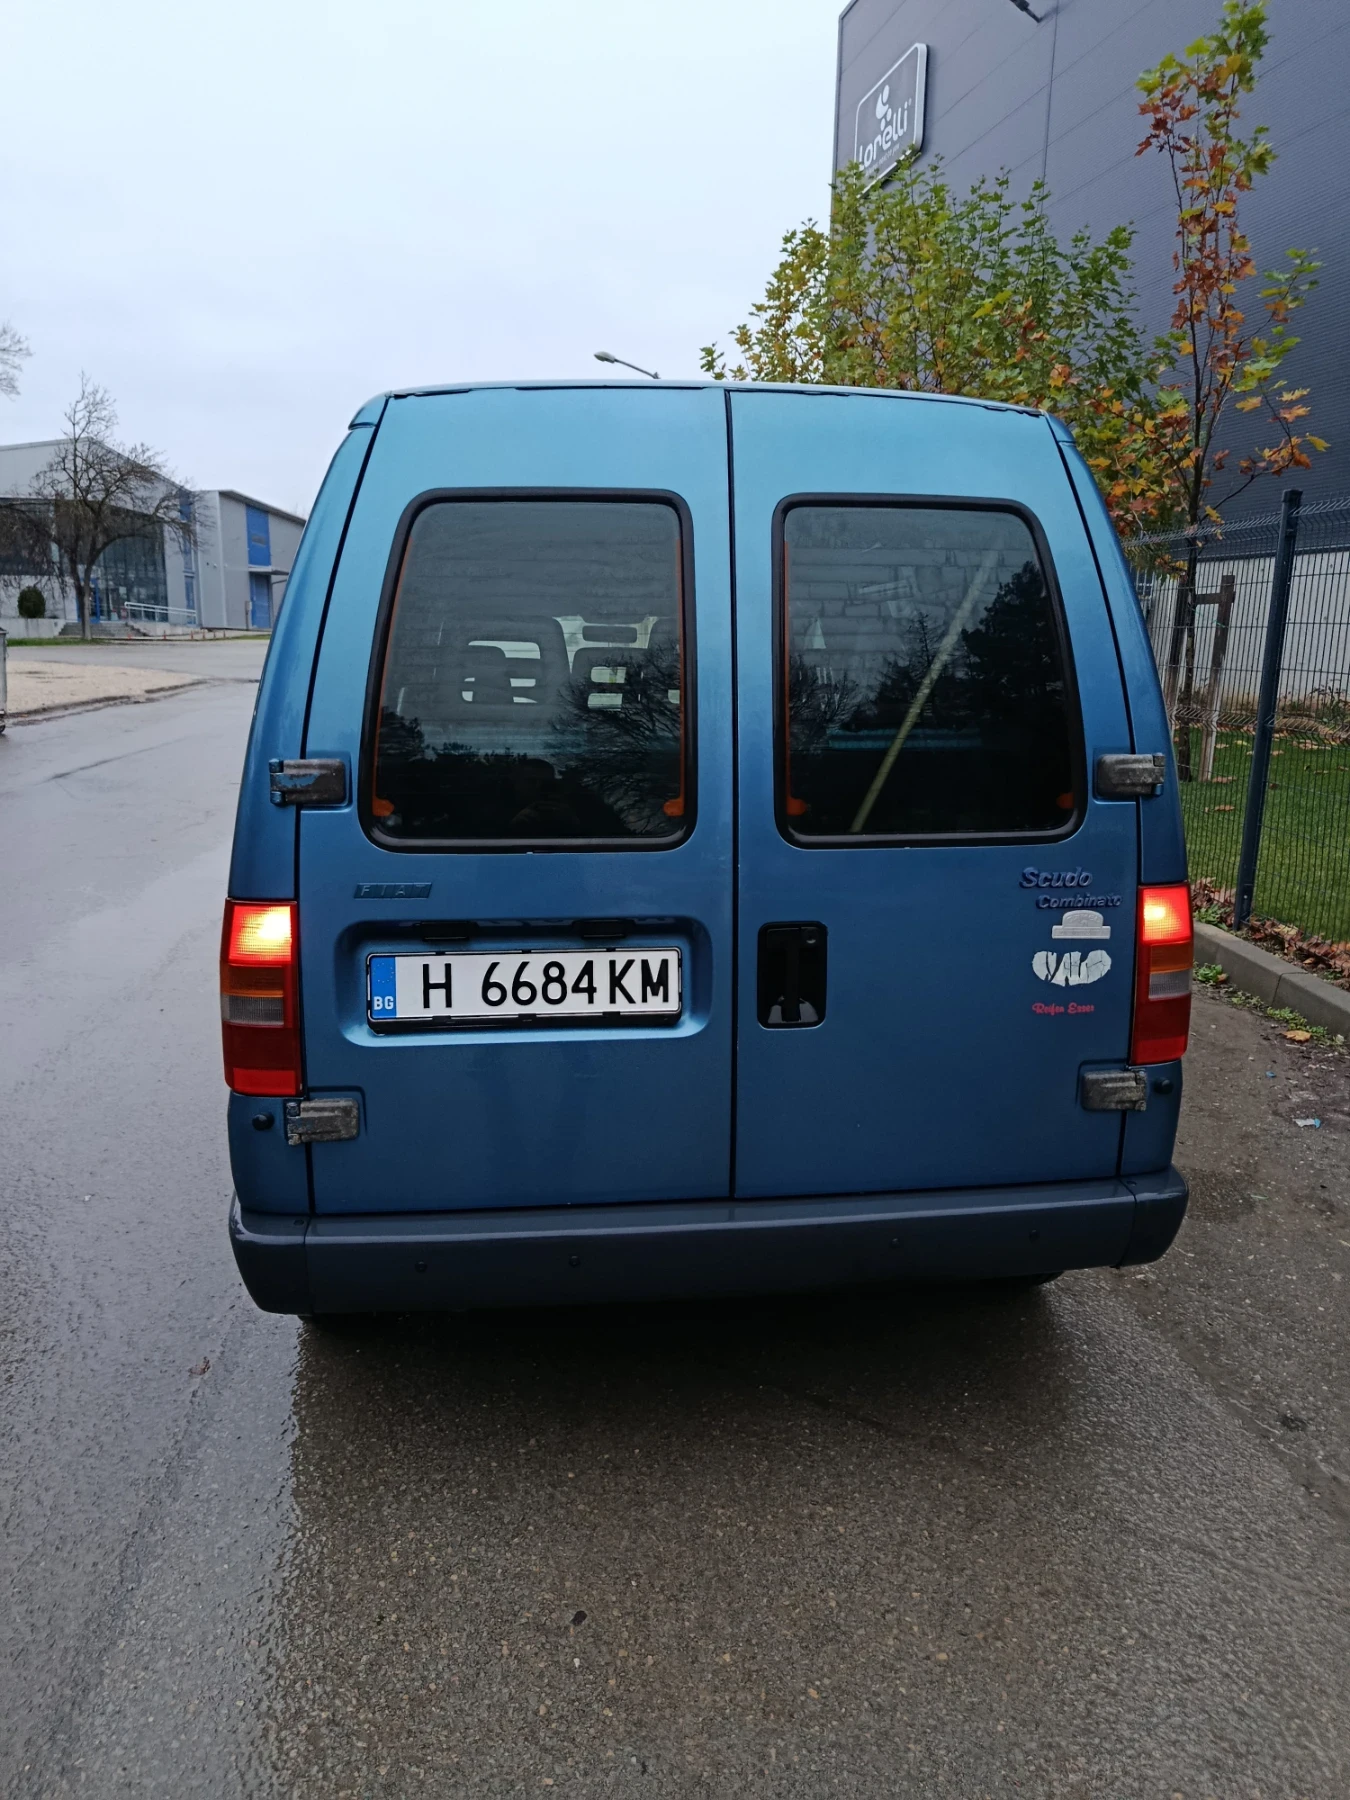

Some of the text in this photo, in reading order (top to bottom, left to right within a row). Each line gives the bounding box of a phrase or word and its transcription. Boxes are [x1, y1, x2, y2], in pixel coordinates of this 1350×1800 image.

[1020, 866, 1093, 888] Scudo
[360, 884, 427, 896] FIAT
[1036, 894, 1122, 908] Combinato
[422, 959, 669, 1008] H 6684 KM
[373, 996, 394, 1010] BG
